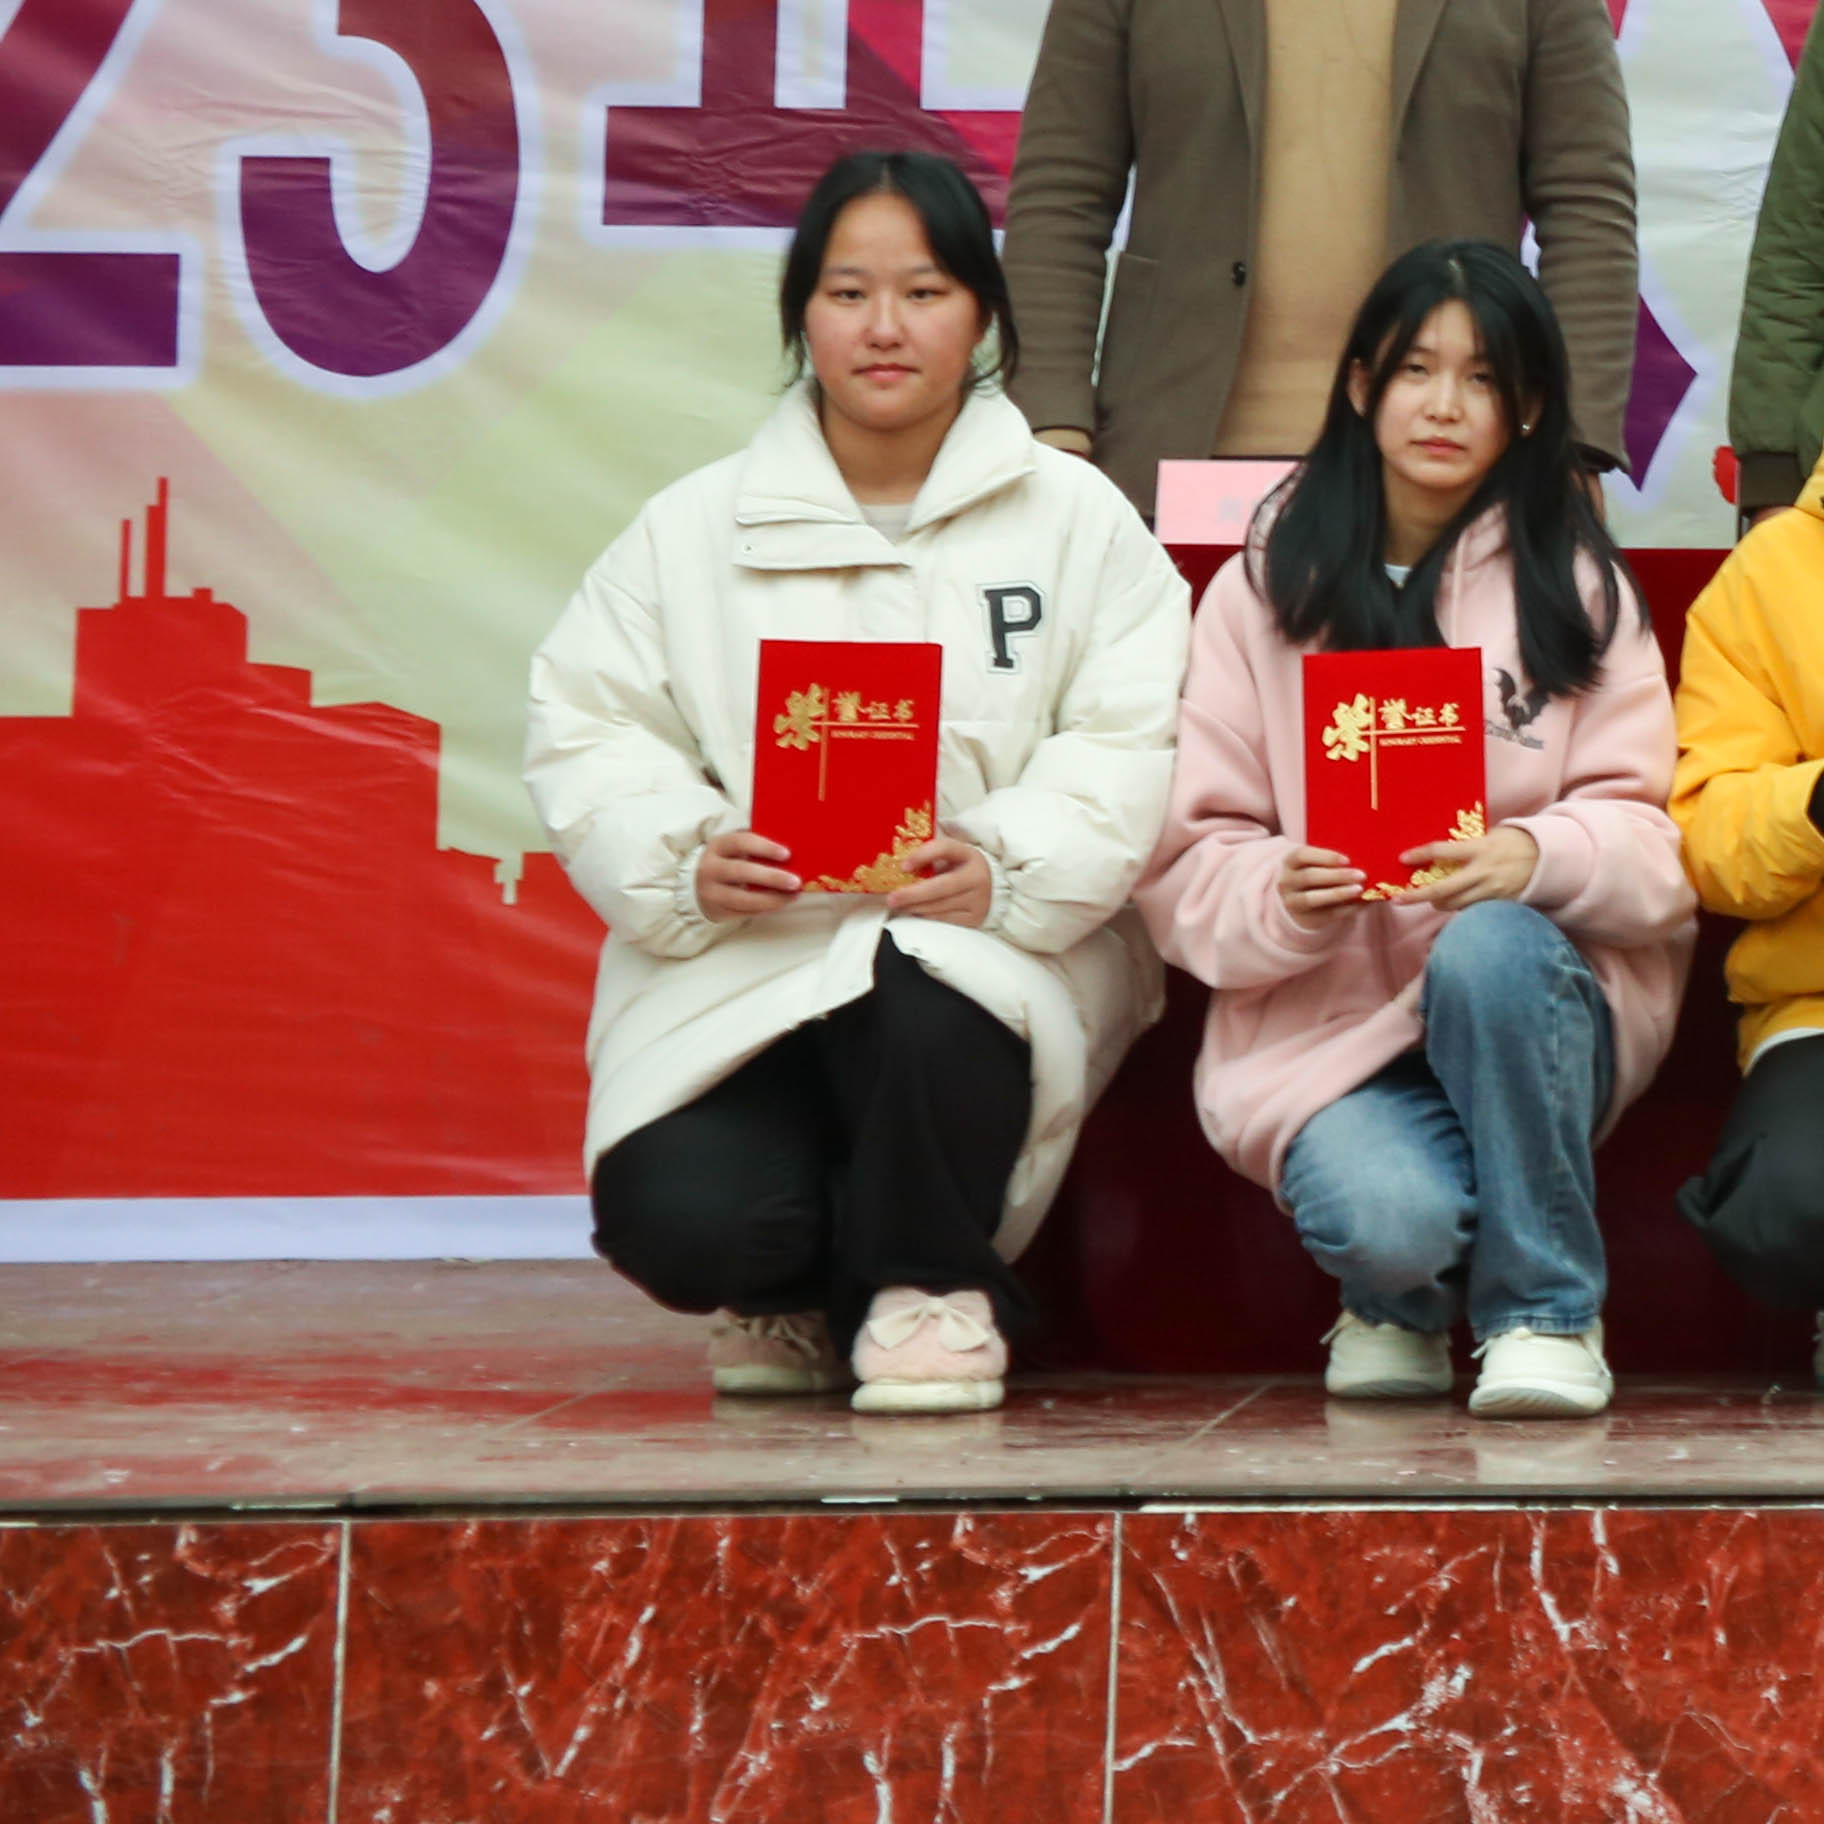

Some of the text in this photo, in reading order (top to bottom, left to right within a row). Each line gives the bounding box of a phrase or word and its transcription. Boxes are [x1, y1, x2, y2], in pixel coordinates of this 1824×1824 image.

[983, 586, 1042, 669] P
[773, 683, 915, 751] 荣誉证书
[1322, 693, 1460, 762] 荣誉证书
